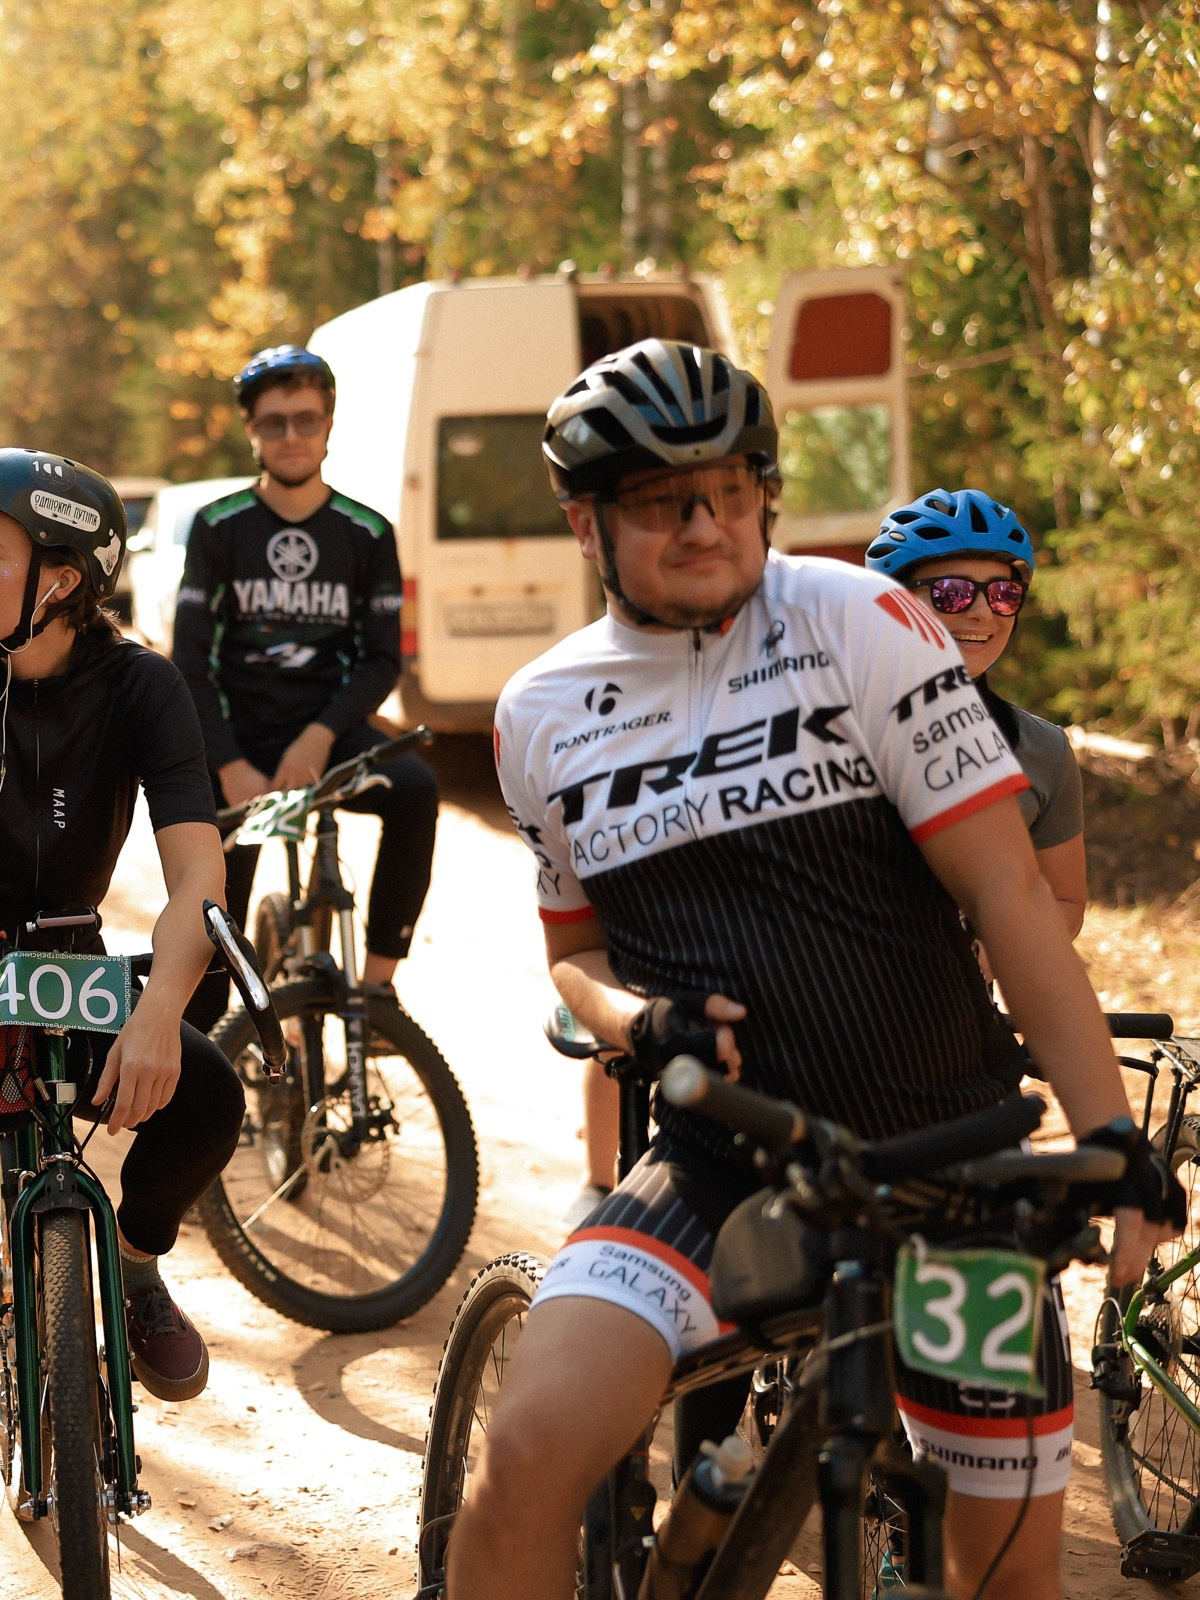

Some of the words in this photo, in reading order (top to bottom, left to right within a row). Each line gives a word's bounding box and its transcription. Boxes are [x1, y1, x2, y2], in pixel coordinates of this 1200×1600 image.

[73, 507, 99, 527] ПУТНИК
[232, 578, 350, 617] YAMAHA
[547, 705, 851, 827] TREK
[52, 788, 66, 829] MAAP
[568, 793, 710, 868] ACTORY
[717, 755, 877, 822] RACING
[587, 1259, 698, 1335] GALAXY
[911, 1262, 1034, 1372] 32
[918, 1438, 1039, 1471] SHIMANO
